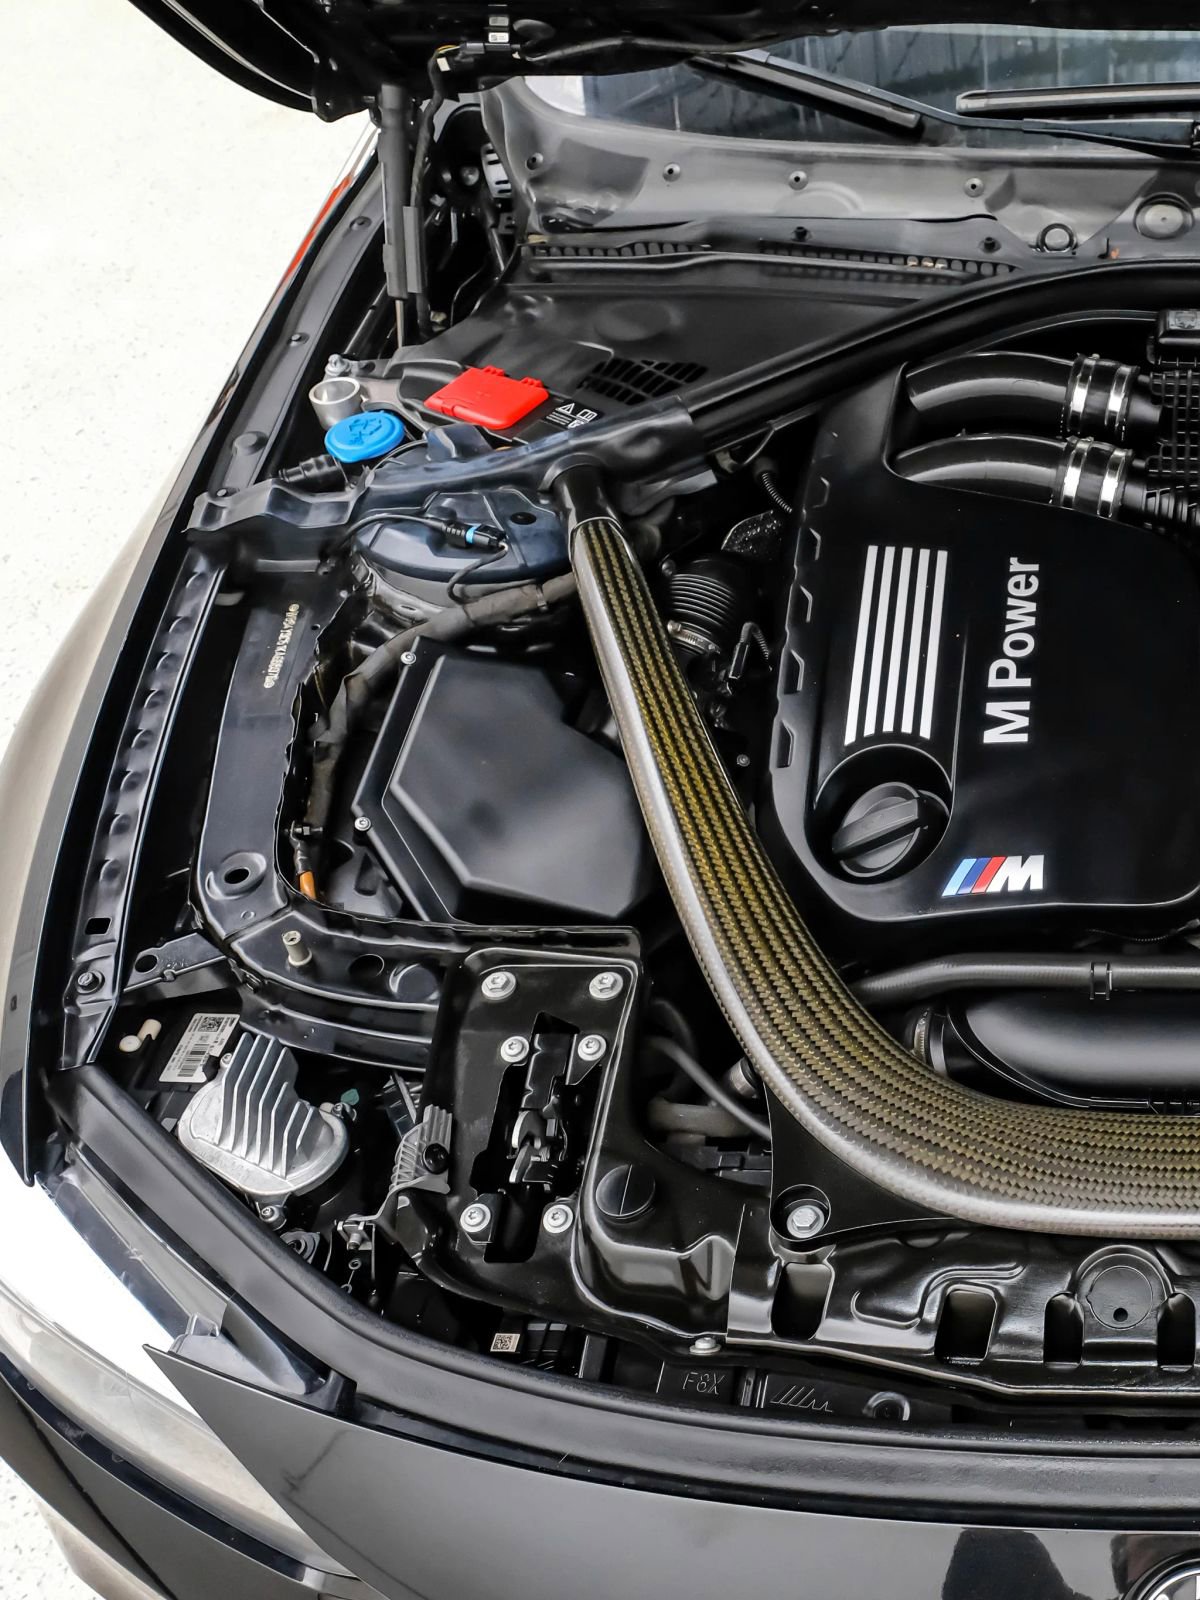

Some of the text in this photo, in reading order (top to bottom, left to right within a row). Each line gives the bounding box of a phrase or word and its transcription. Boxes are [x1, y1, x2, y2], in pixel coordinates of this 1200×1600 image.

[983, 557, 1040, 744] M Power
[985, 854, 1045, 893] M
[682, 1371, 725, 1396] F8X
